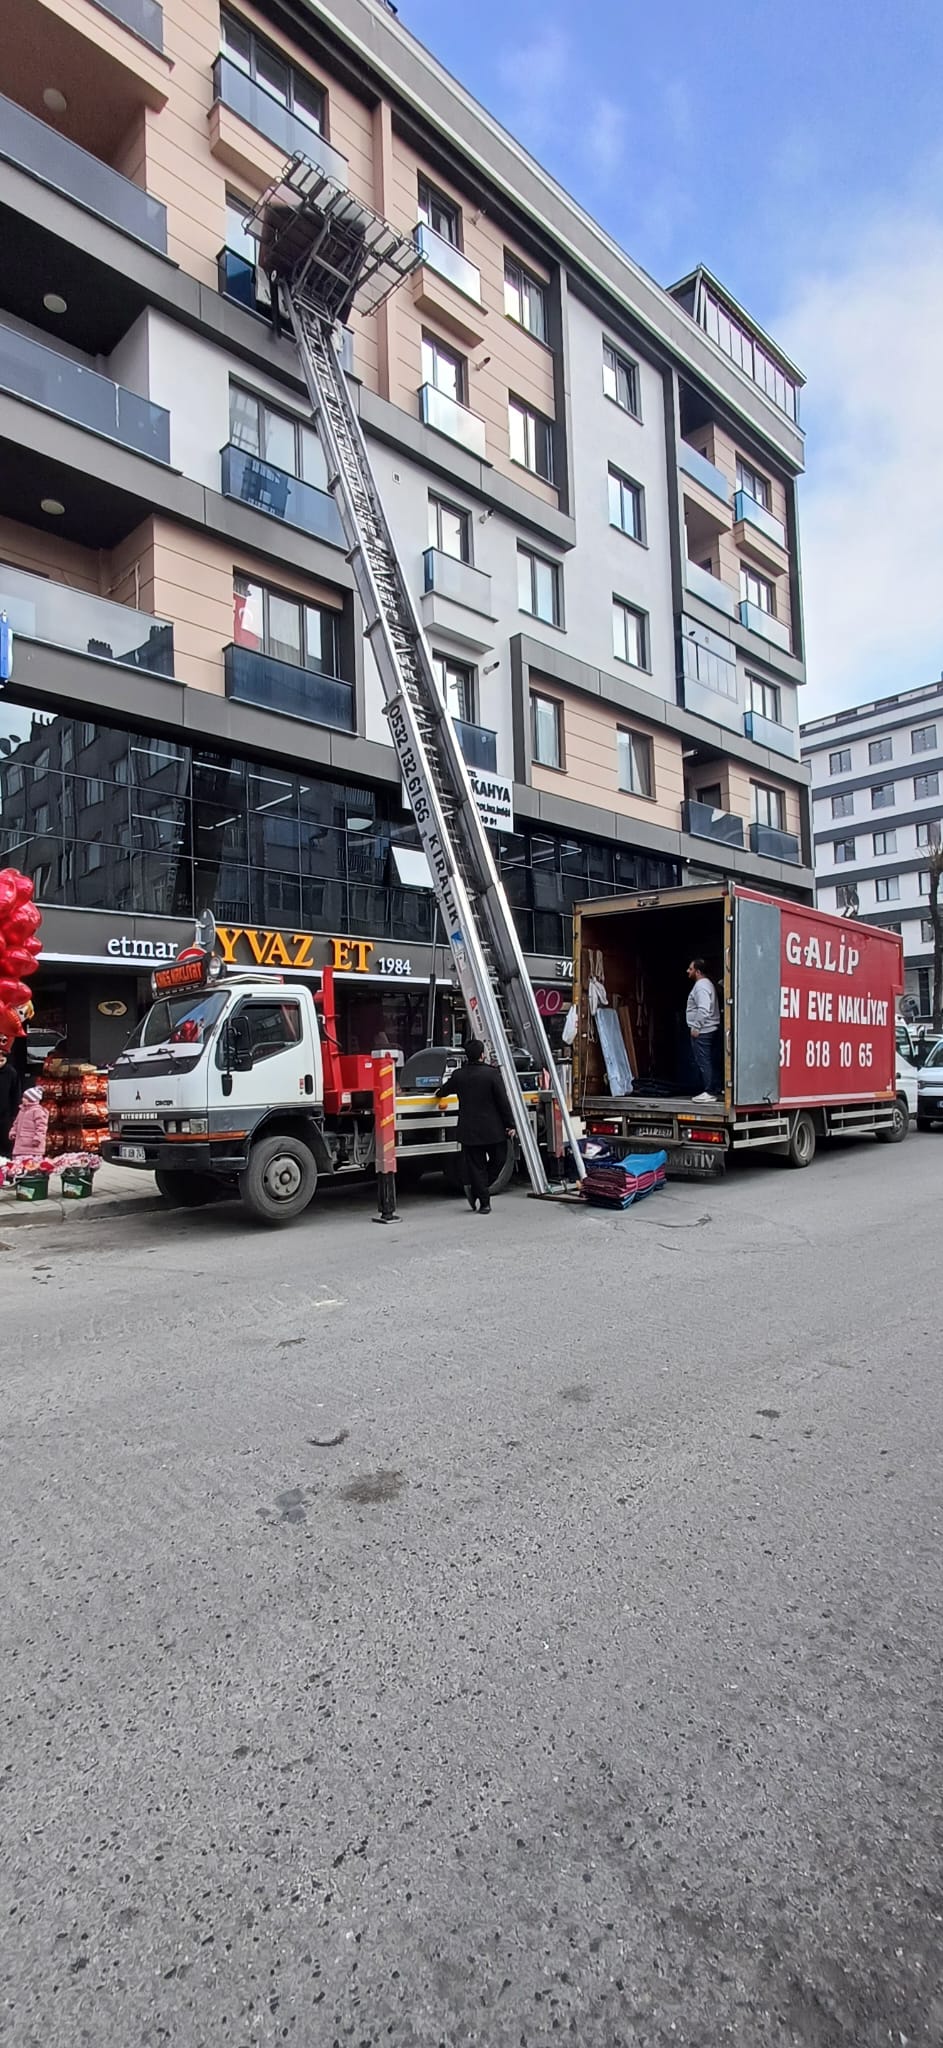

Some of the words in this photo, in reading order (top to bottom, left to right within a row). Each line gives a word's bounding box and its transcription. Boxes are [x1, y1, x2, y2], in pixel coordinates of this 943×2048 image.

[389, 704, 409, 749] 0532
[401, 747, 417, 779] 132
[408, 776, 424, 799] 61
[470, 779, 511, 803] KAHYA
[414, 797, 430, 824] 66
[107, 935, 179, 959] etmar
[215, 927, 314, 967] YVAZ
[330, 938, 374, 972] ET
[785, 931, 860, 975] GALİP
[378, 957, 412, 975] 1984
[535, 988, 561, 1012] CO
[780, 986, 801, 1019] EN
[807, 990, 833, 1022] EVE
[838, 991, 889, 1027] NAKLİYAT
[805, 1039, 830, 1068] 818
[839, 1041, 852, 1068] 10
[859, 1042, 873, 1068] 65
